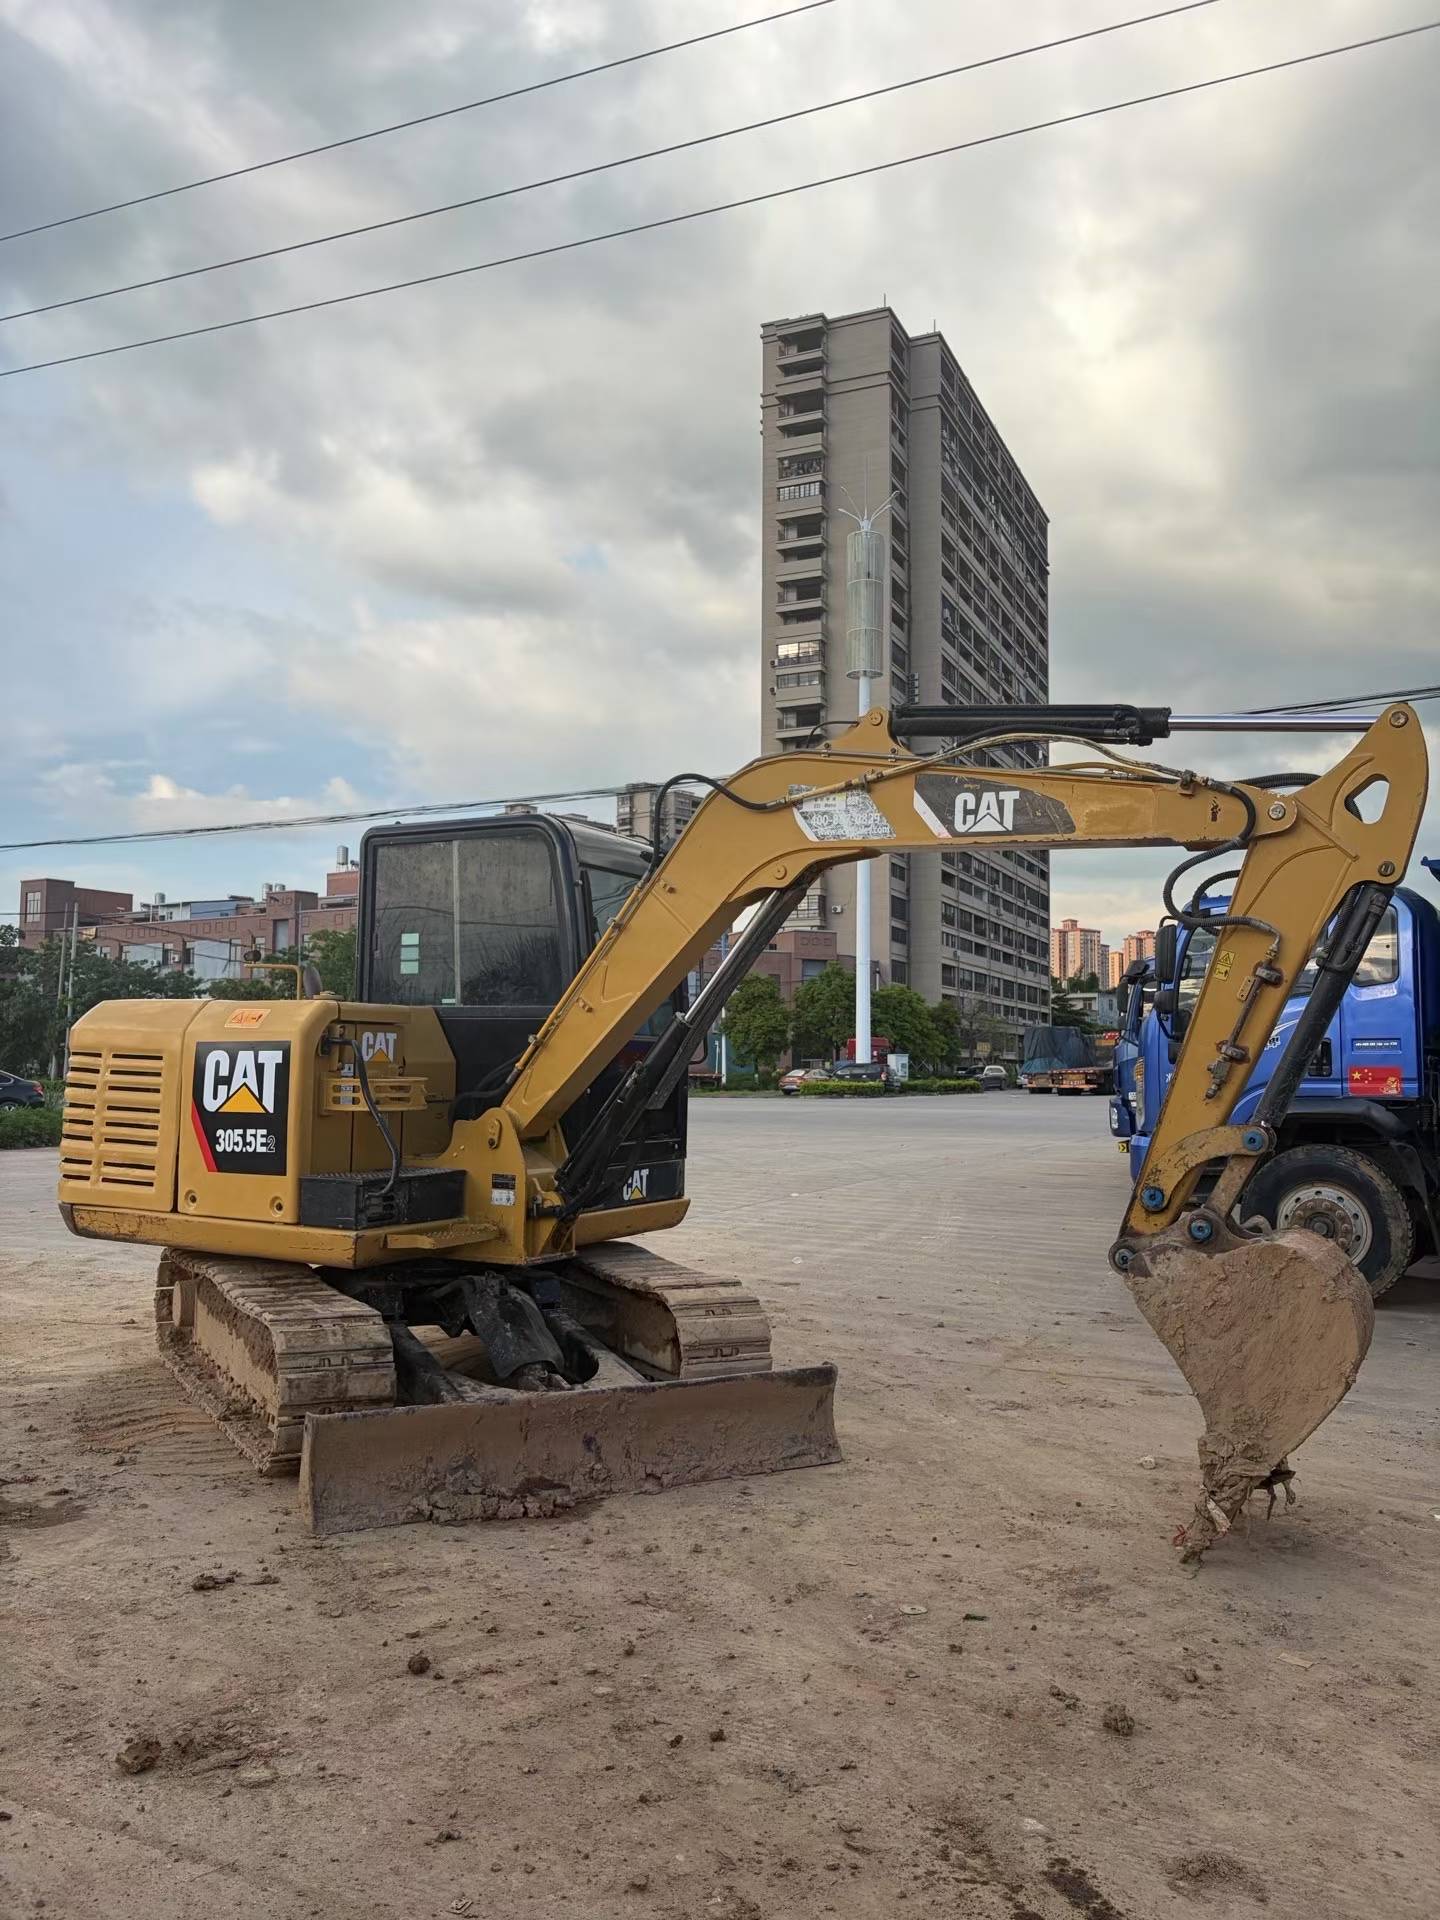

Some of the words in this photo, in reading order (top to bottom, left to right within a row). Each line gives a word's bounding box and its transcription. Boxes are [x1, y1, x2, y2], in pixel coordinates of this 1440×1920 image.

[954, 790, 1020, 832] CAT
[361, 1031, 397, 1063] CAT
[203, 1050, 283, 1113] CAT
[215, 1128, 276, 1153] 305.5E2
[622, 1168, 649, 1201] CAT
